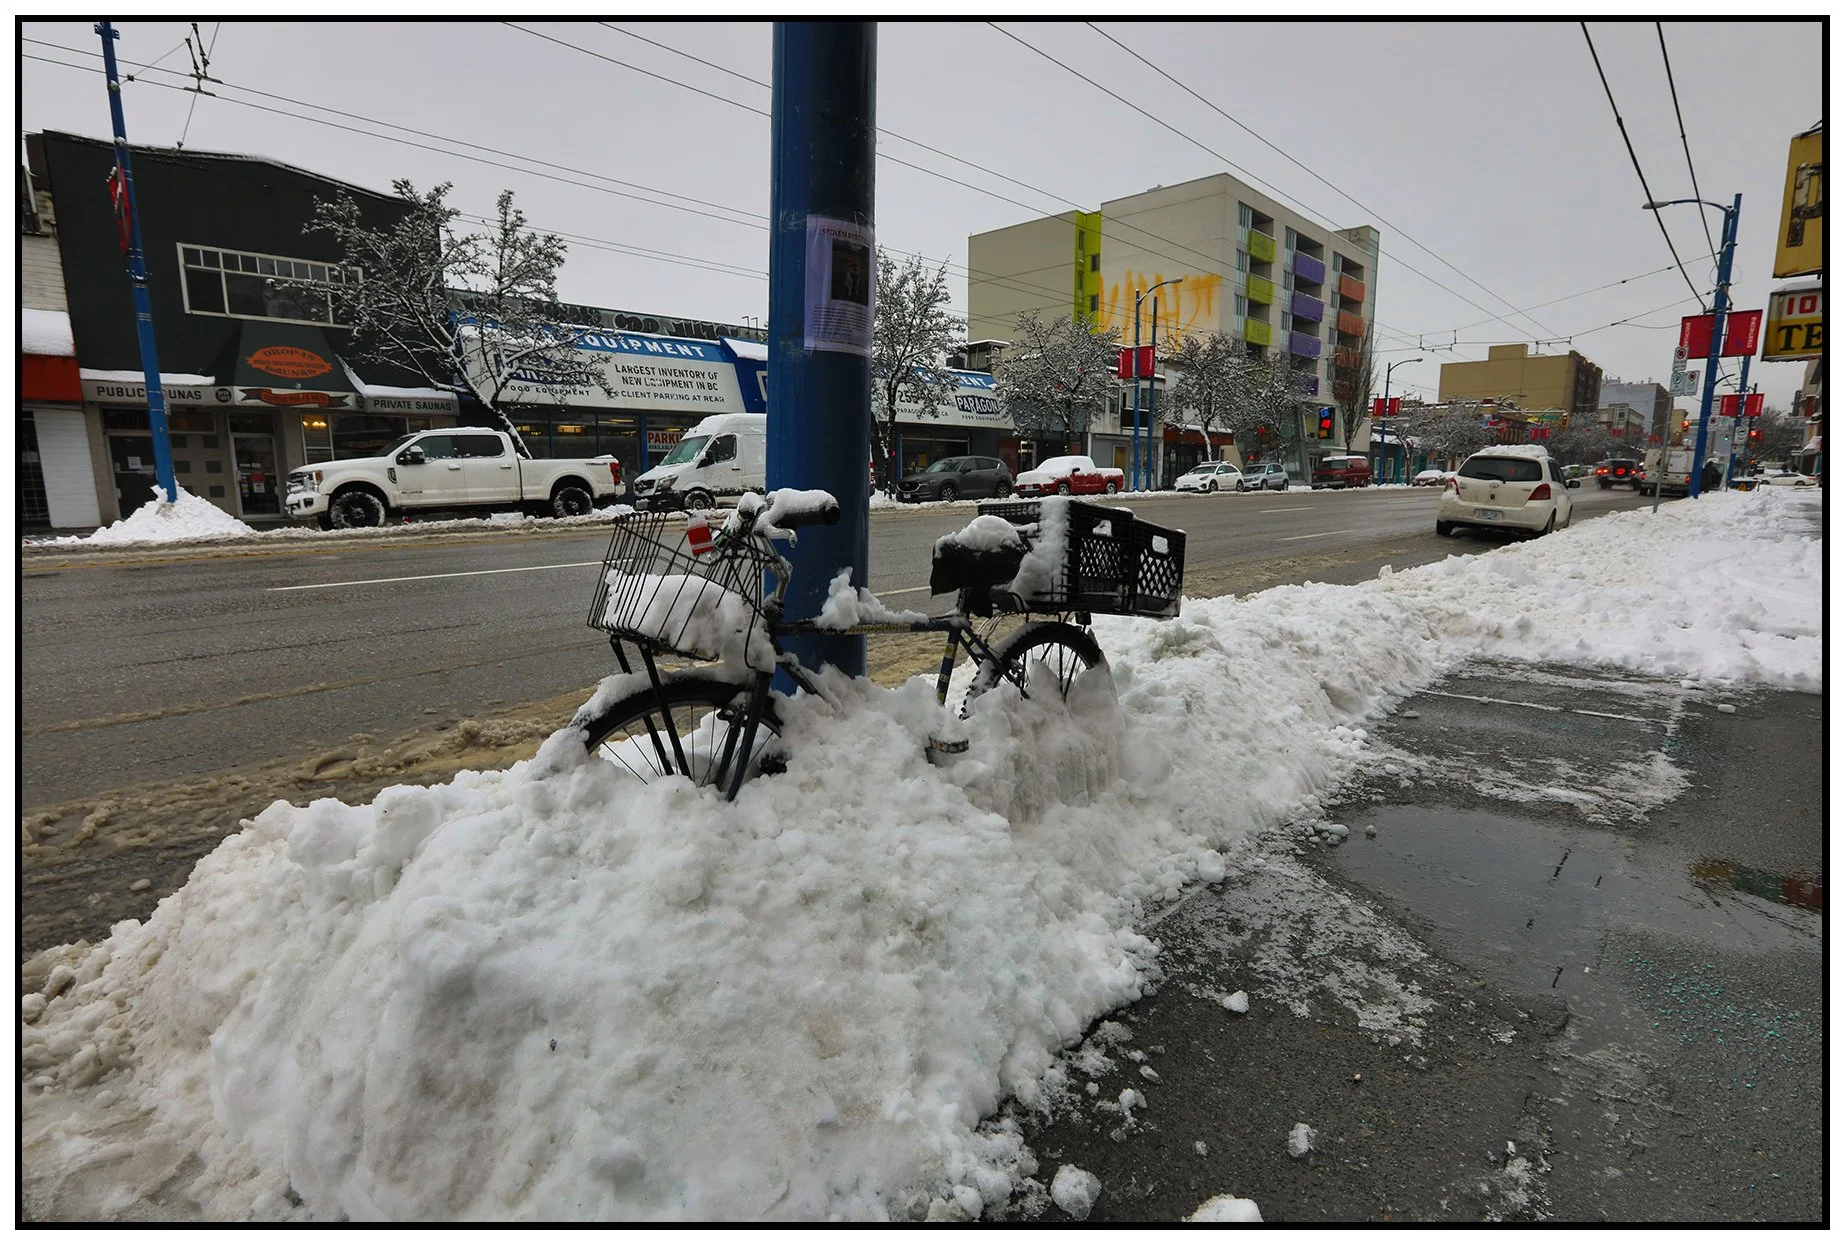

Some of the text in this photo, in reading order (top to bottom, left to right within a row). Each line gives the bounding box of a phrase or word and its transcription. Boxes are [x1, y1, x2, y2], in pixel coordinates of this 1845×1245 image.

[615, 364, 719, 381] LARGEST INVENTORY OF
[622, 376, 642, 387] NEW
[696, 381, 706, 390] IN
[707, 382, 719, 391] BC
[96, 386, 145, 399] PUBLIC
[621, 390, 725, 404] CLIENT PARKING AT REAR
[373, 399, 412, 410] PRIVATE
[416, 401, 452, 411] SAUNAS
